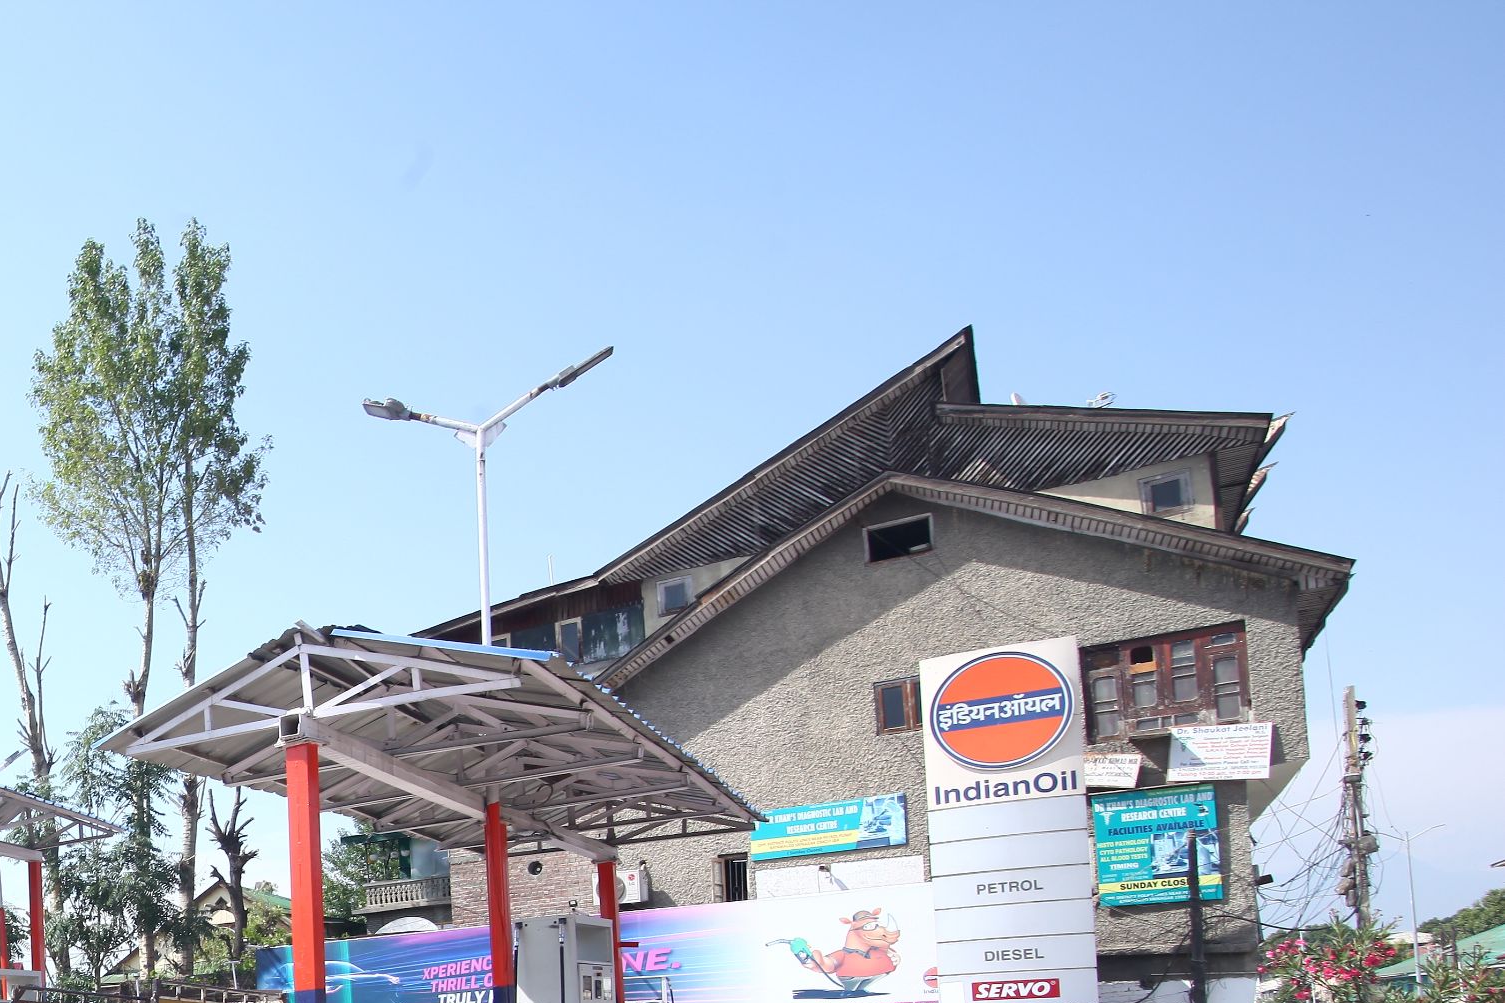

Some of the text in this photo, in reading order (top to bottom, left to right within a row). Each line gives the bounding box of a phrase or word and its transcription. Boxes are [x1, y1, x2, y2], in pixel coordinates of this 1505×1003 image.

[939, 693, 1062, 731] इंडियनऑयल
[1233, 724, 1268, 732] Jeelani
[935, 770, 1077, 805] IndianOil
[1135, 796, 1179, 808] DIAGNOSTIC
[1180, 794, 1195, 803] LAB
[1196, 792, 1215, 801] AND
[798, 808, 832, 820] DIAGNOSTIC
[833, 807, 844, 816] LAB
[845, 805, 859, 814] AND
[1121, 807, 1187, 822] RESEARCH CENTRE
[786, 820, 837, 834] RESEARCH CENTRE
[1108, 820, 1205, 836] FACILITIES AVAILABLE
[1110, 862, 1139, 870] TIMING
[977, 880, 1043, 895] PETROL
[1120, 878, 1189, 891] SUNDAY CLOS
[984, 948, 1045, 962] DIESEL
[431, 976, 479, 993] THRILL
[976, 982, 1051, 999] SERVO
